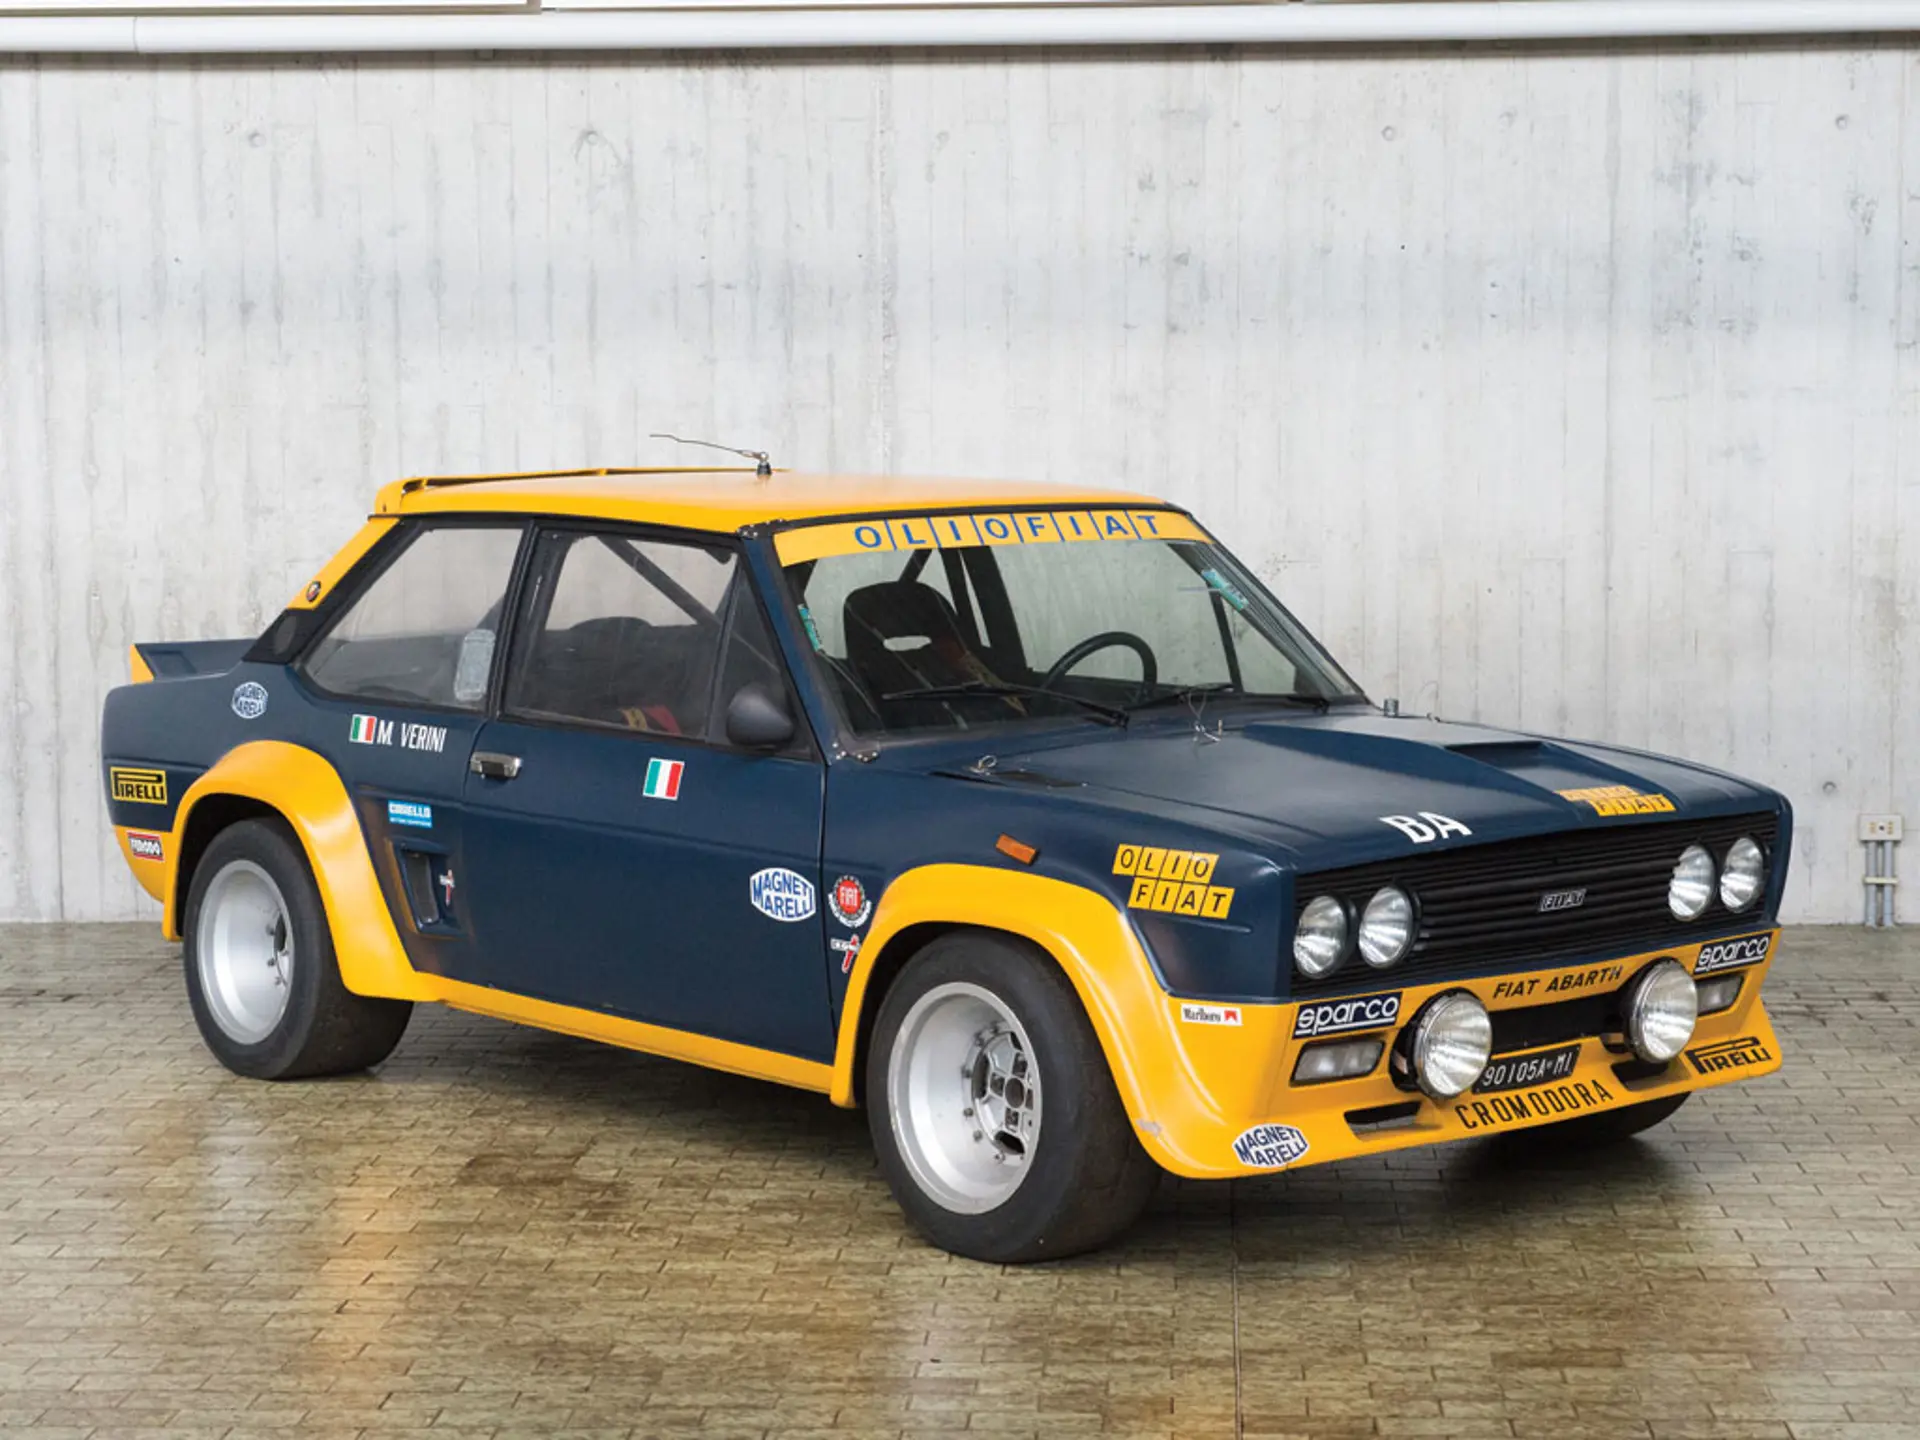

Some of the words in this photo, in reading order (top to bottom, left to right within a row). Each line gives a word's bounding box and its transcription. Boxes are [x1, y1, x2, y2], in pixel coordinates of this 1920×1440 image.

[401, 723, 447, 753] VERINI
[113, 771, 165, 800] PIRELLI
[1597, 796, 1667, 812] FIAT
[1380, 811, 1472, 843] BA
[1120, 848, 1210, 878] OLIO
[753, 871, 813, 904] MAGNETI
[1135, 886, 1227, 914] FIAT
[1700, 936, 1769, 972] sparco
[1492, 979, 1540, 999] FIAT
[1544, 965, 1623, 992] ABARTH
[1297, 996, 1399, 1033] sparco
[1685, 1036, 1772, 1075] PIRELLI
[1455, 1079, 1613, 1129] CROMODORA
[1234, 1126, 1307, 1158] MAGNETI
